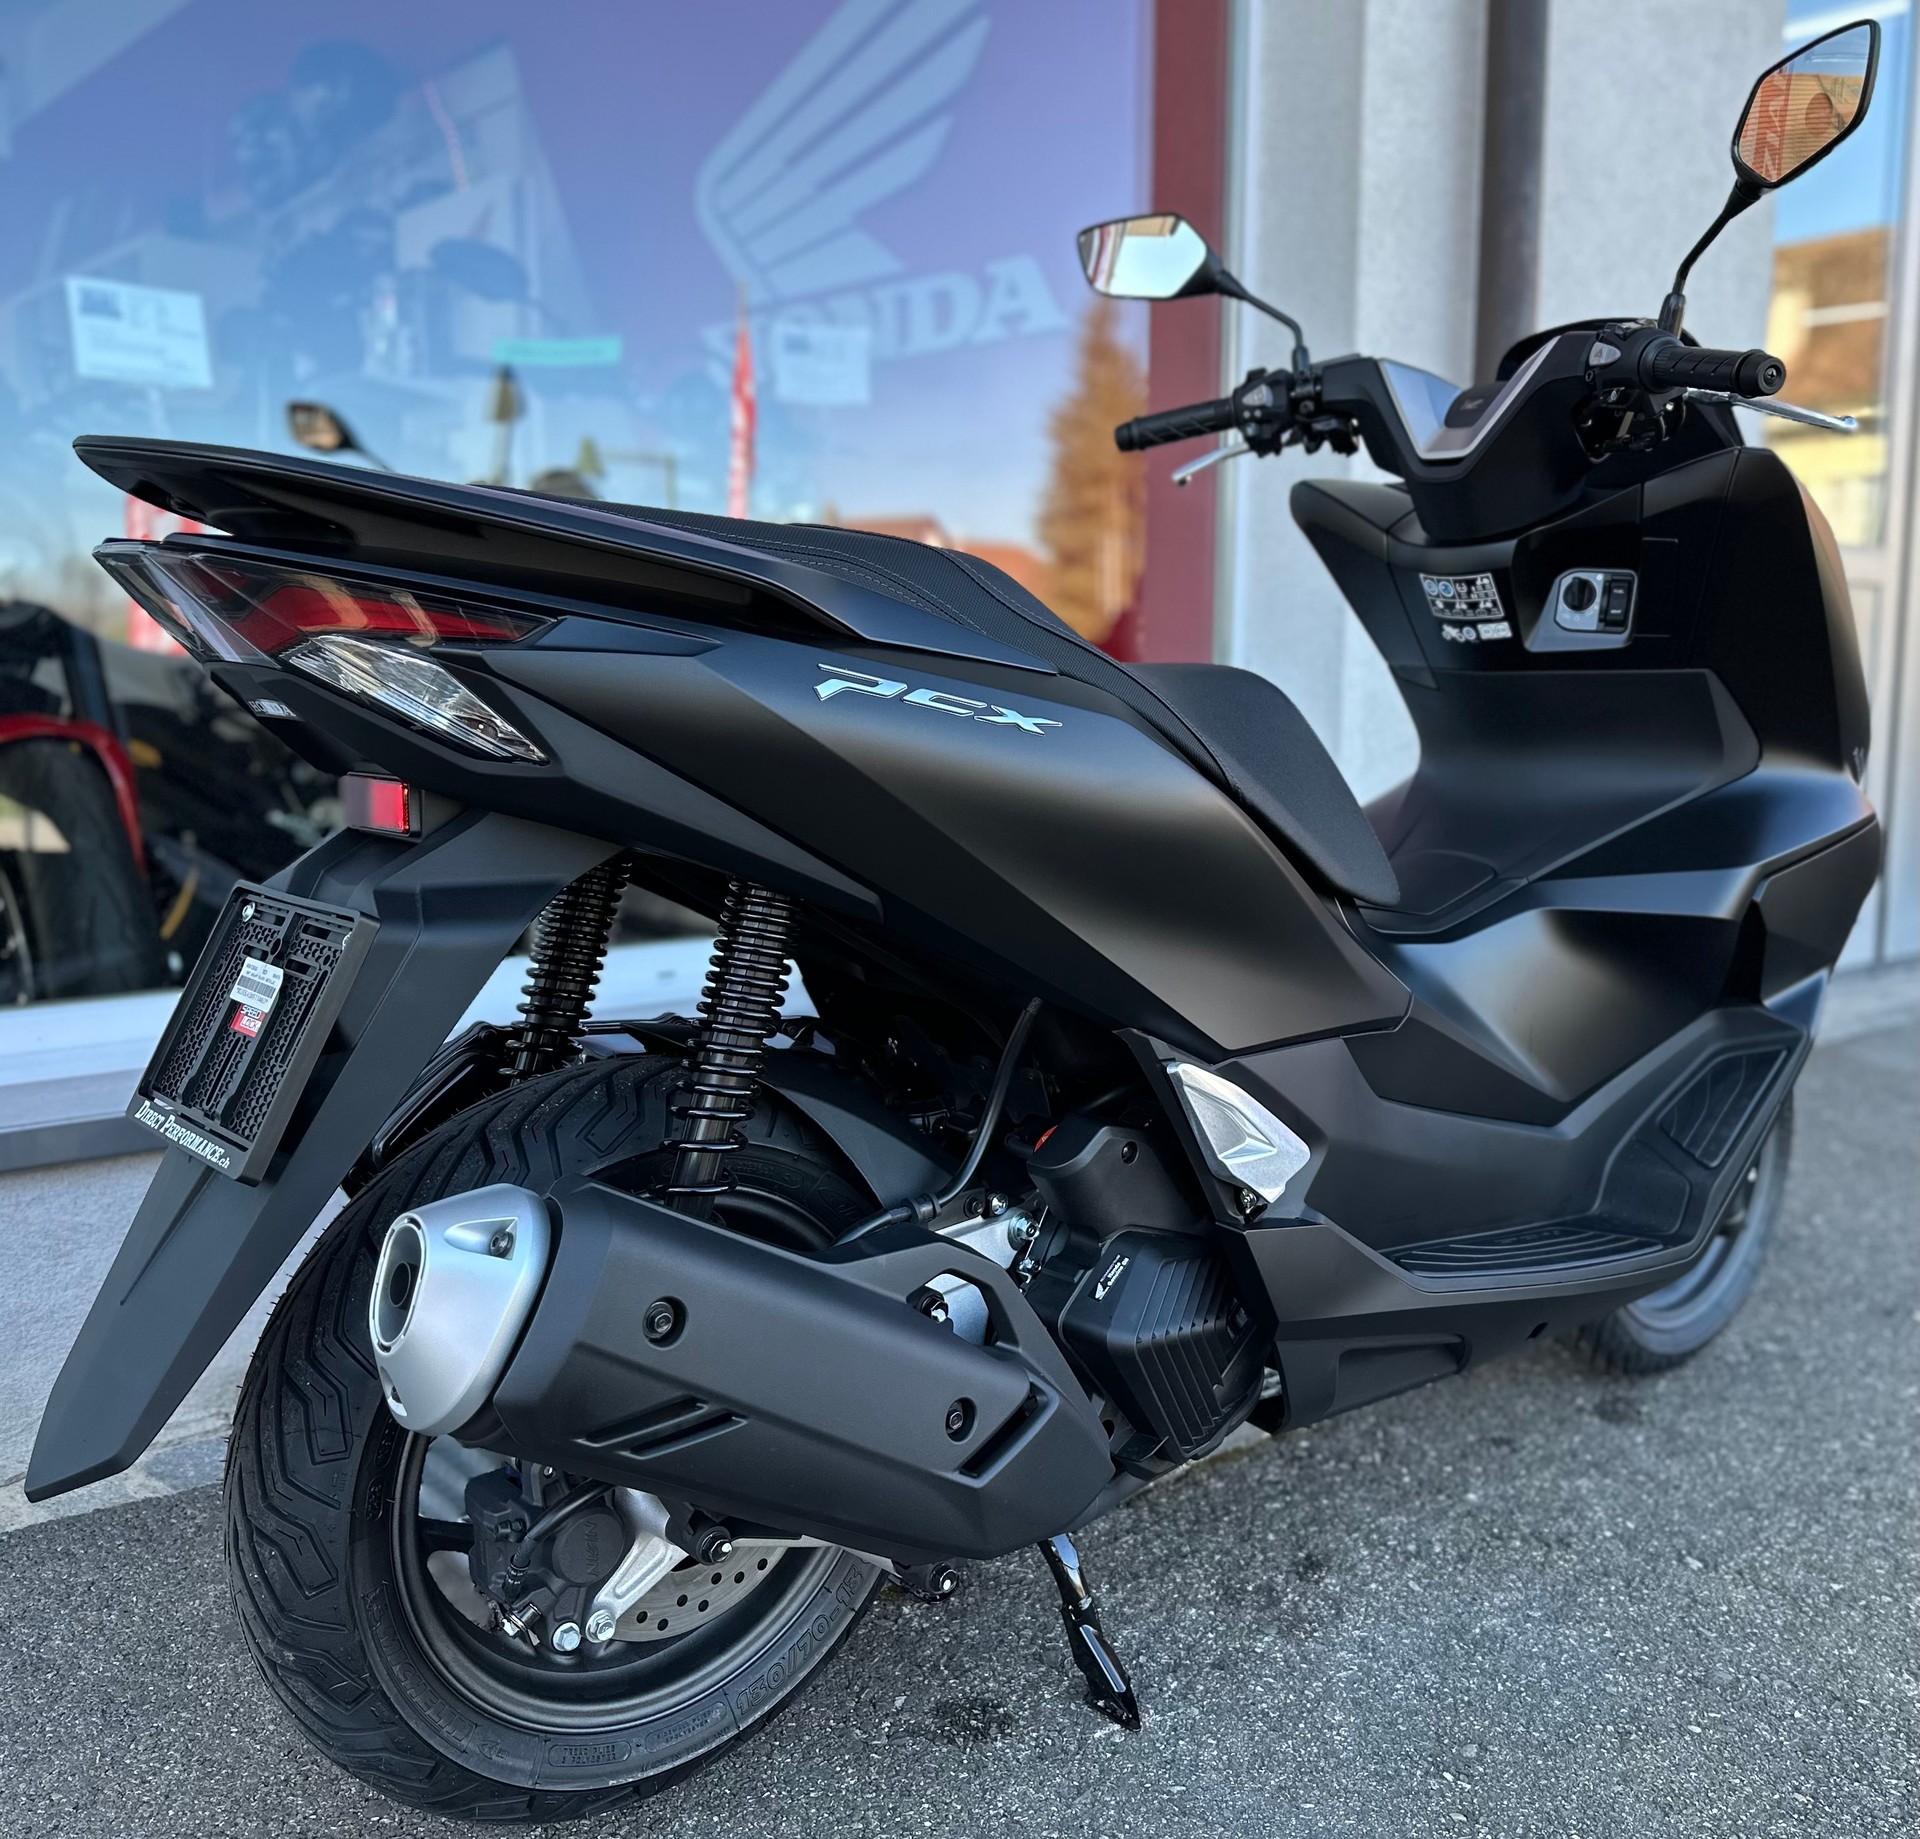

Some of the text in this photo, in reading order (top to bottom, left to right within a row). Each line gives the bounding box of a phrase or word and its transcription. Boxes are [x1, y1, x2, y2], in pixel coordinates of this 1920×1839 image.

[813, 663, 1063, 736] PCX
[134, 1100, 230, 1169] DIRECT PERFORMANCE.ch
[380, 1631, 474, 1742] MICHELIN
